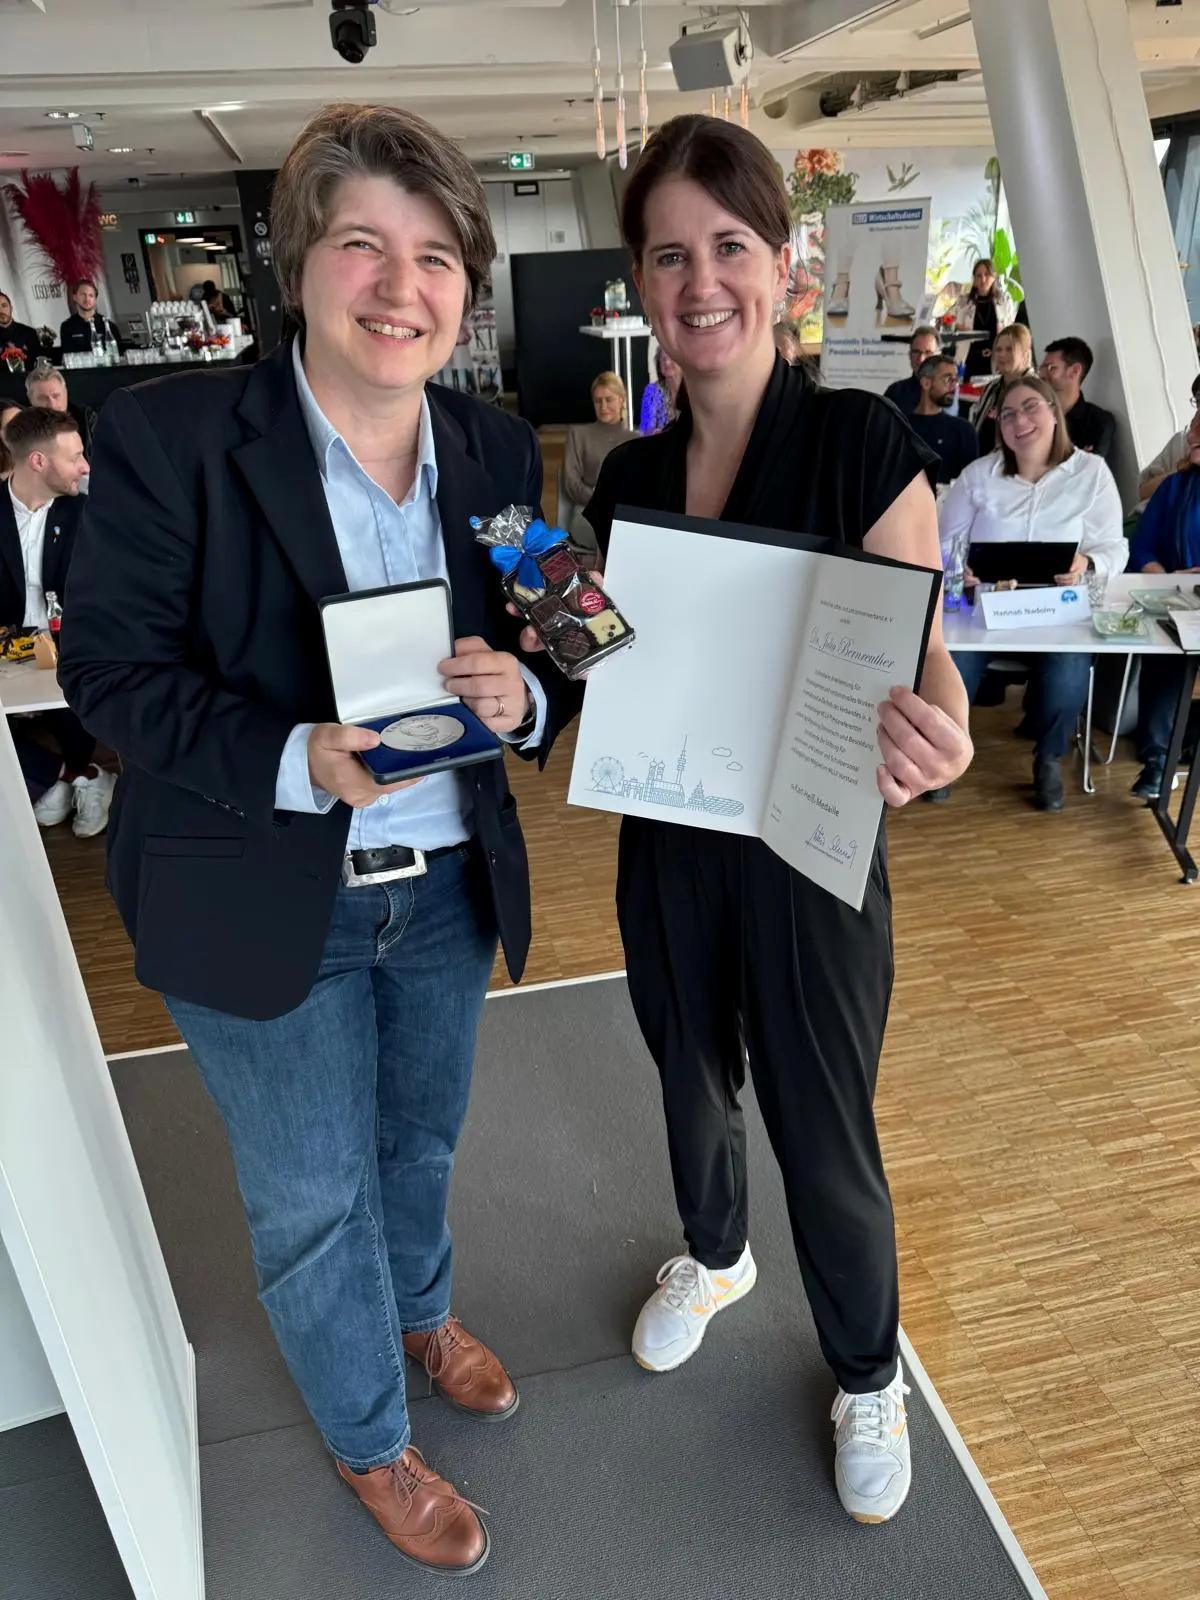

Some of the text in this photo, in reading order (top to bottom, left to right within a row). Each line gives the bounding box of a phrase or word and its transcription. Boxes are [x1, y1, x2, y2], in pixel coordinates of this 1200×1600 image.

[992, 606, 1056, 617] Hannah Nadolny
[838, 636, 895, 669] Bernreuther
